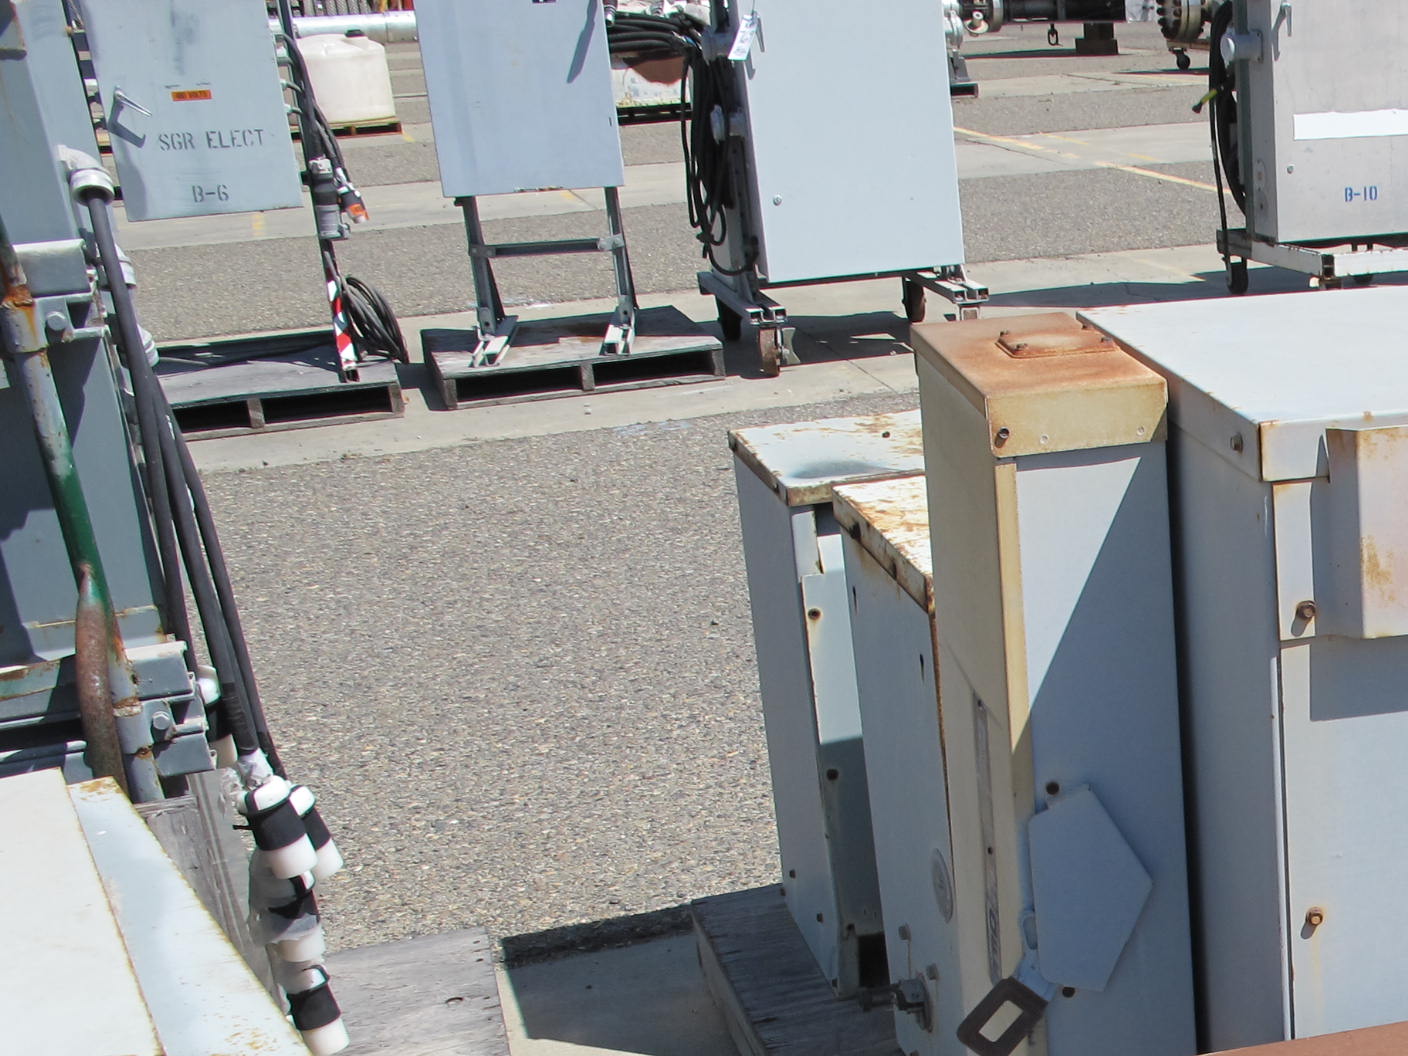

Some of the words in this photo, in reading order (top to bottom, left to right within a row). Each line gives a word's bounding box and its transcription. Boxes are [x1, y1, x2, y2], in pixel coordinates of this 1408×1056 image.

[158, 133, 196, 151] SGR
[206, 129, 264, 149] ELECT
[1344, 186, 1378, 202] B-10
